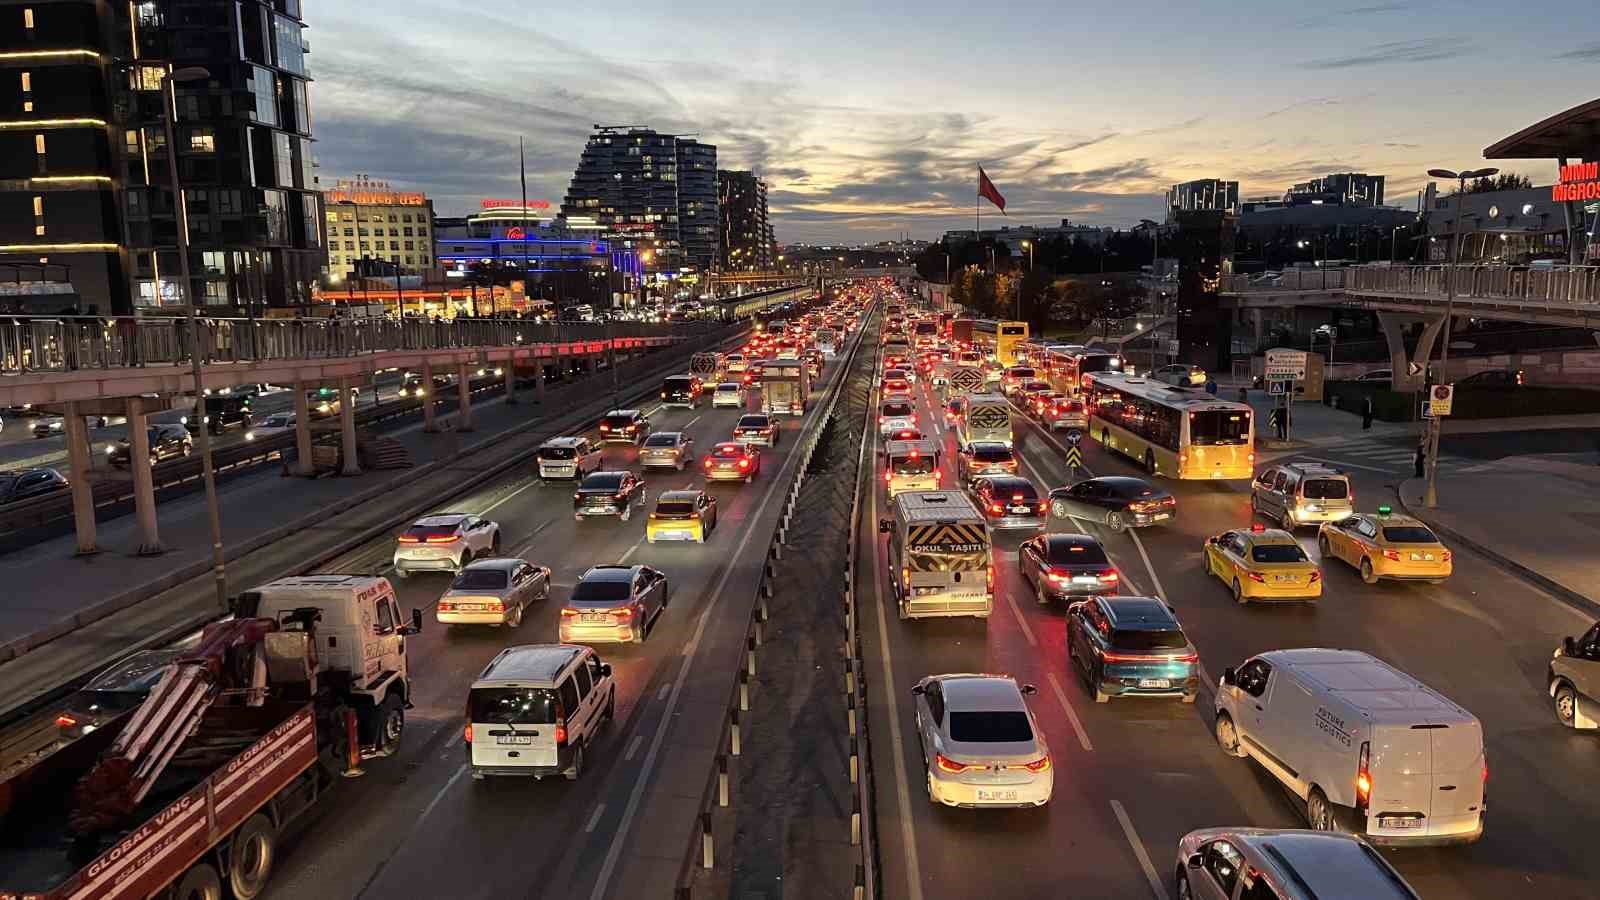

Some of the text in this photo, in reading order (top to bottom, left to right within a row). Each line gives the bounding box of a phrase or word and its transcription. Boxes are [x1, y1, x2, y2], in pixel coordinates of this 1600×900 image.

[1561, 162, 1598, 181] MMM
[228, 736, 273, 773] GLOBAL
[88, 826, 152, 878] GLOBAL
